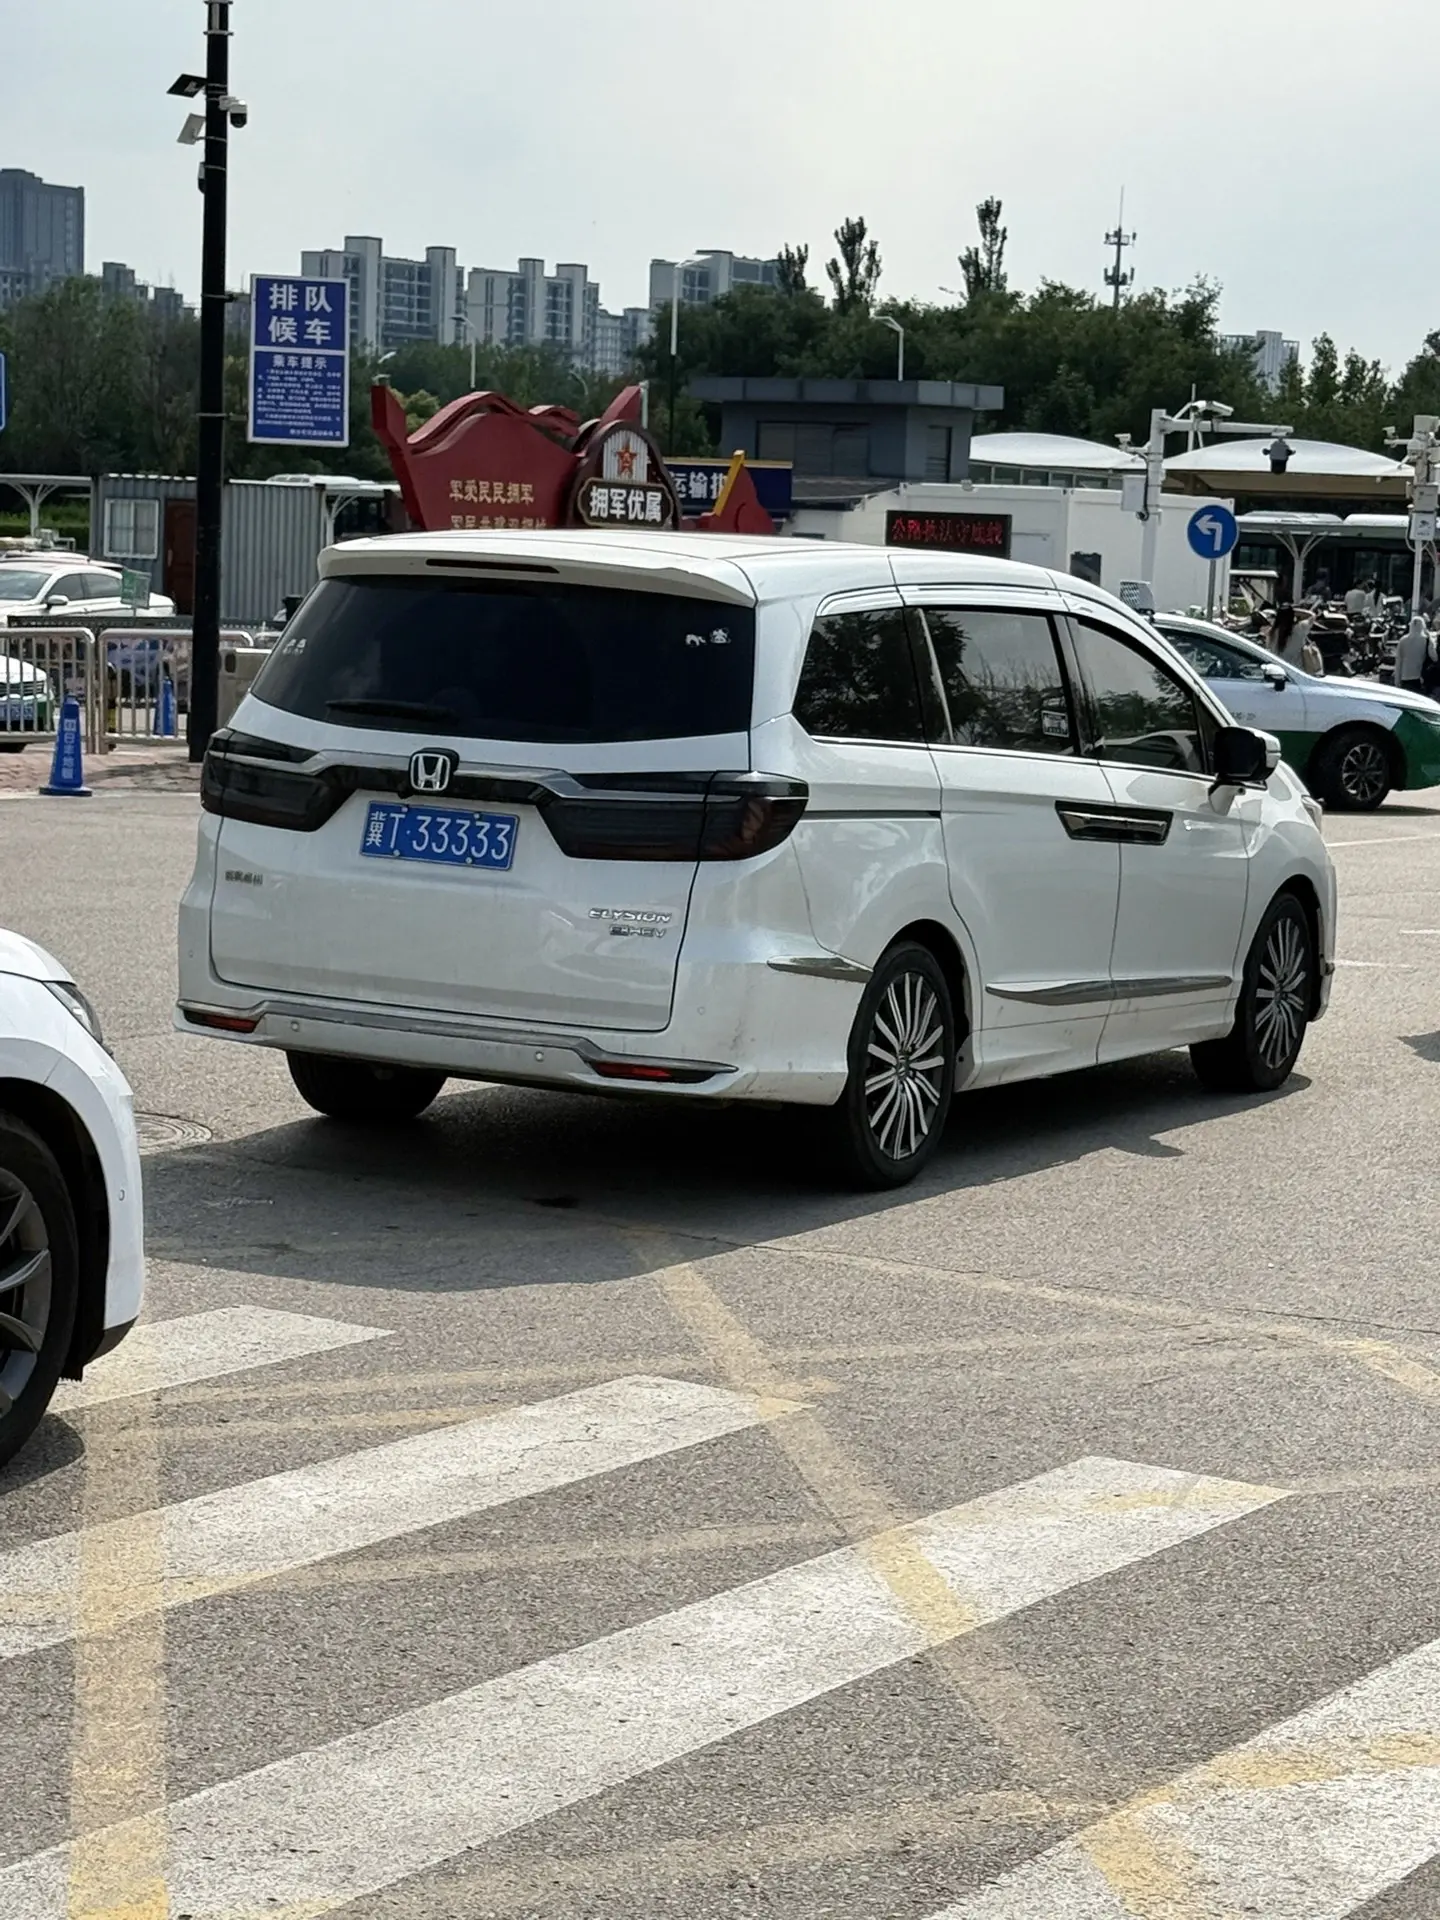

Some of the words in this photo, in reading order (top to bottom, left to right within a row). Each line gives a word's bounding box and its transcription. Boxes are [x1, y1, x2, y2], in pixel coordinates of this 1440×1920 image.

[269, 282, 333, 313] 排队
[268, 315, 332, 345] 候车
[449, 479, 535, 505] 军爱民民拥军
[590, 485, 662, 523] 拥军优属
[589, 908, 672, 923] ELYSION
